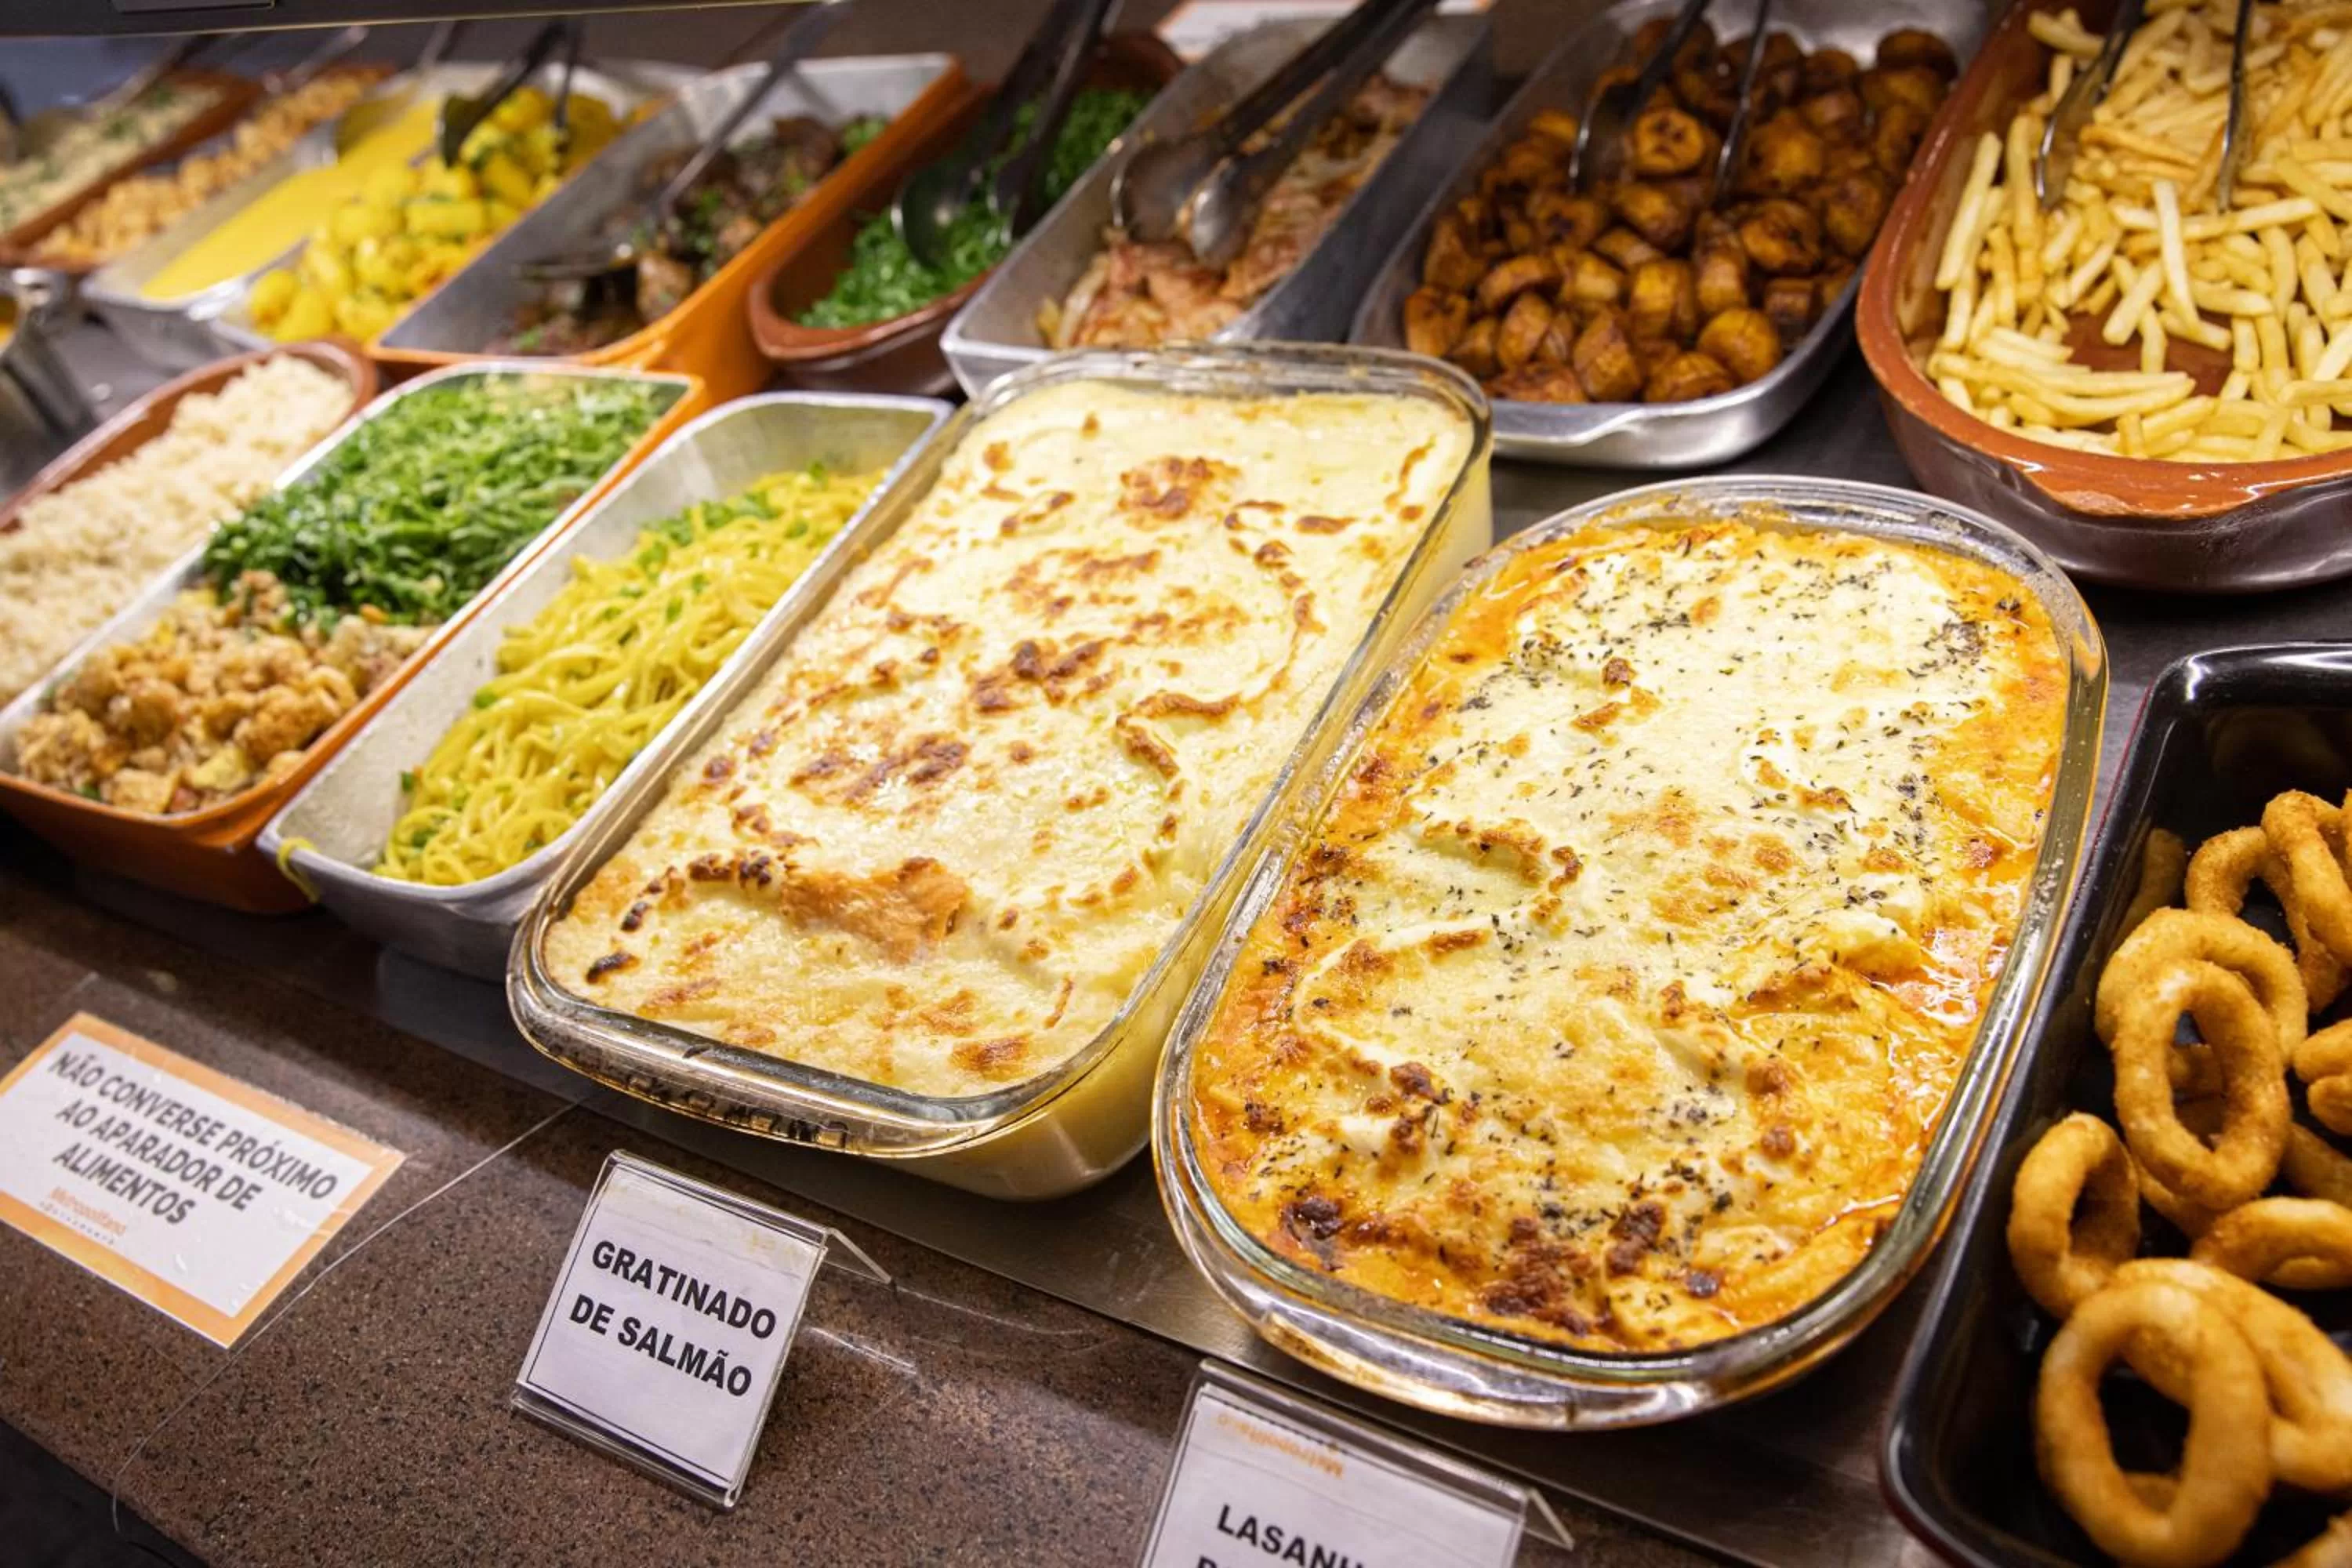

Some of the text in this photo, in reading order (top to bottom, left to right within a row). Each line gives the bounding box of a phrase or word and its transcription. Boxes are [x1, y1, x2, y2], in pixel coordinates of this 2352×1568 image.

[48, 1051, 338, 1200] NÃO CONVERSE PRÓXIMO
[56, 1099, 263, 1211] AO APARADOR DE
[53, 1143, 196, 1224] ALIMENTOS
[592, 1240, 776, 1339] GRATINADO
[569, 1294, 752, 1397] DE SALMÃO
